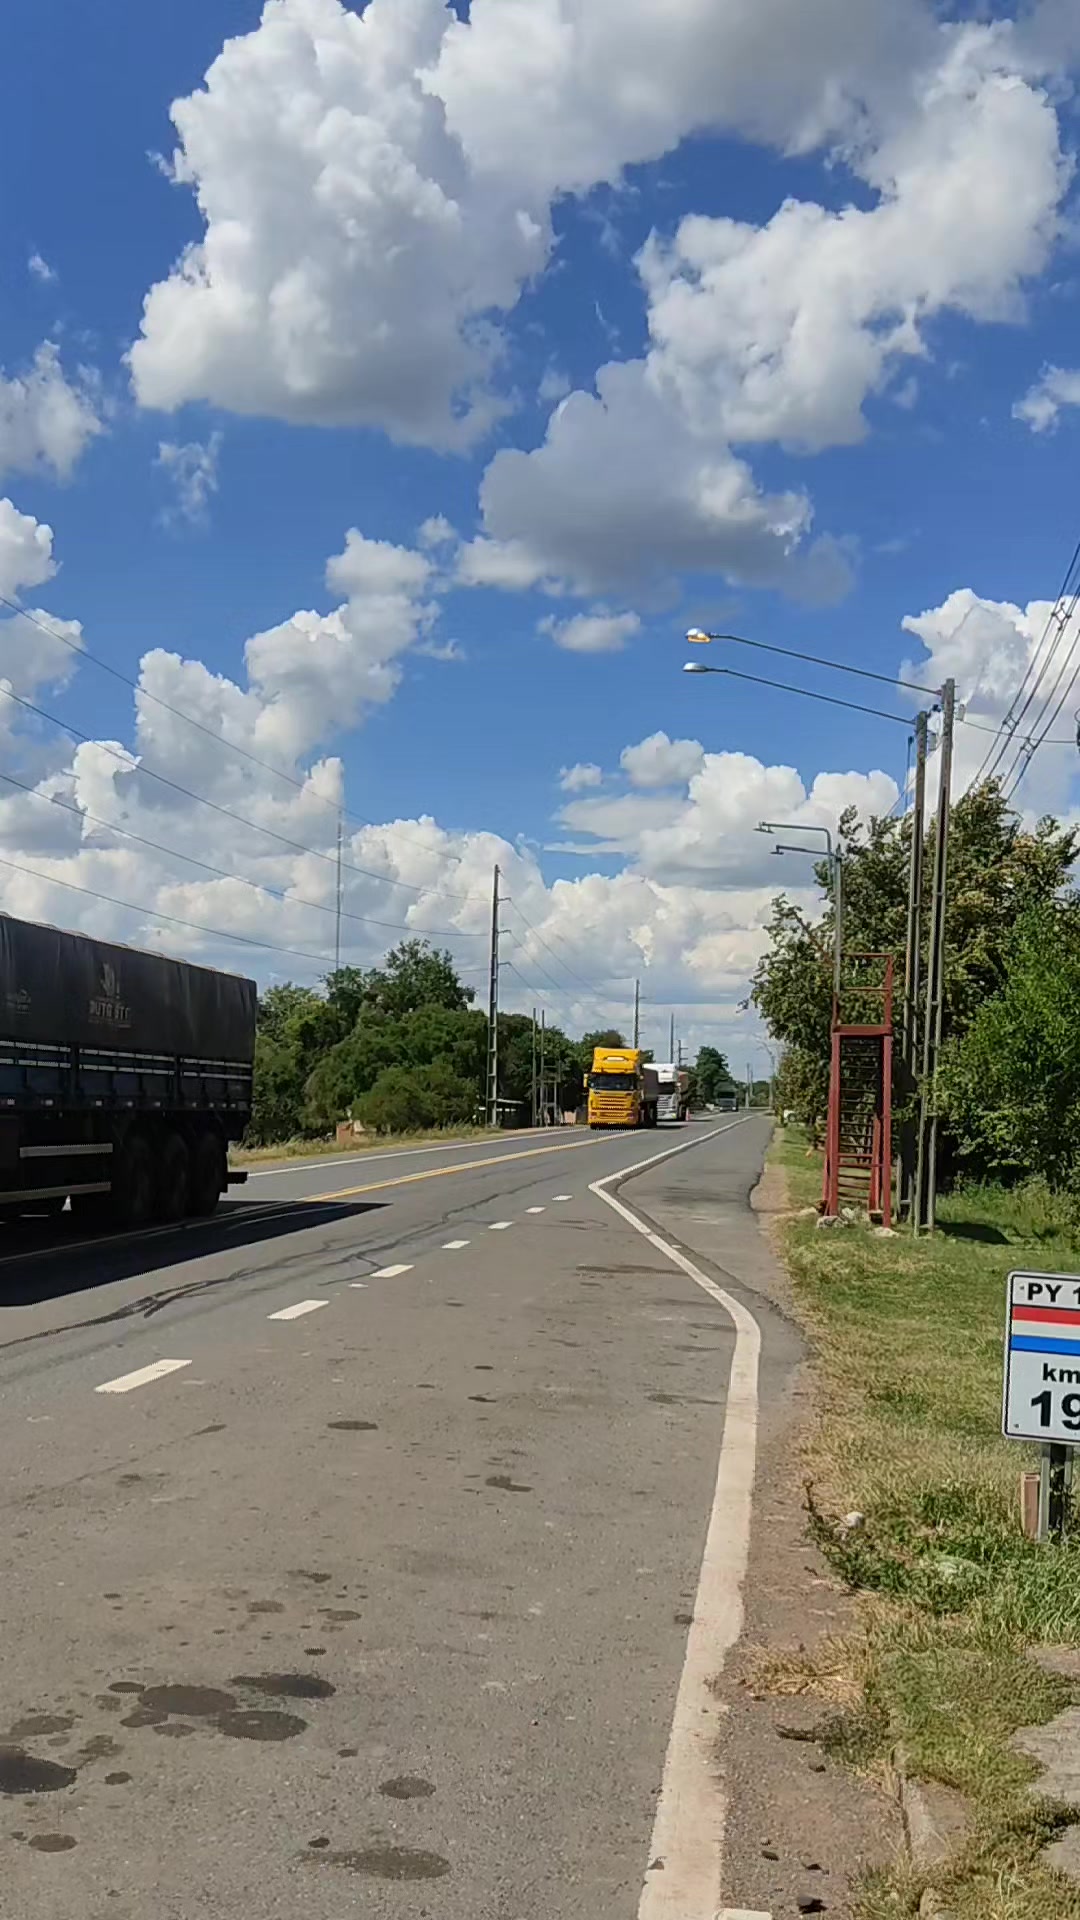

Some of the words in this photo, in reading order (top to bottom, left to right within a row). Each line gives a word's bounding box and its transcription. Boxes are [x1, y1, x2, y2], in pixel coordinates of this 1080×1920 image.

[1028, 1282, 1062, 1303] PY
[1042, 1362, 1080, 1385] km
[1031, 1390, 1080, 1430] 19
